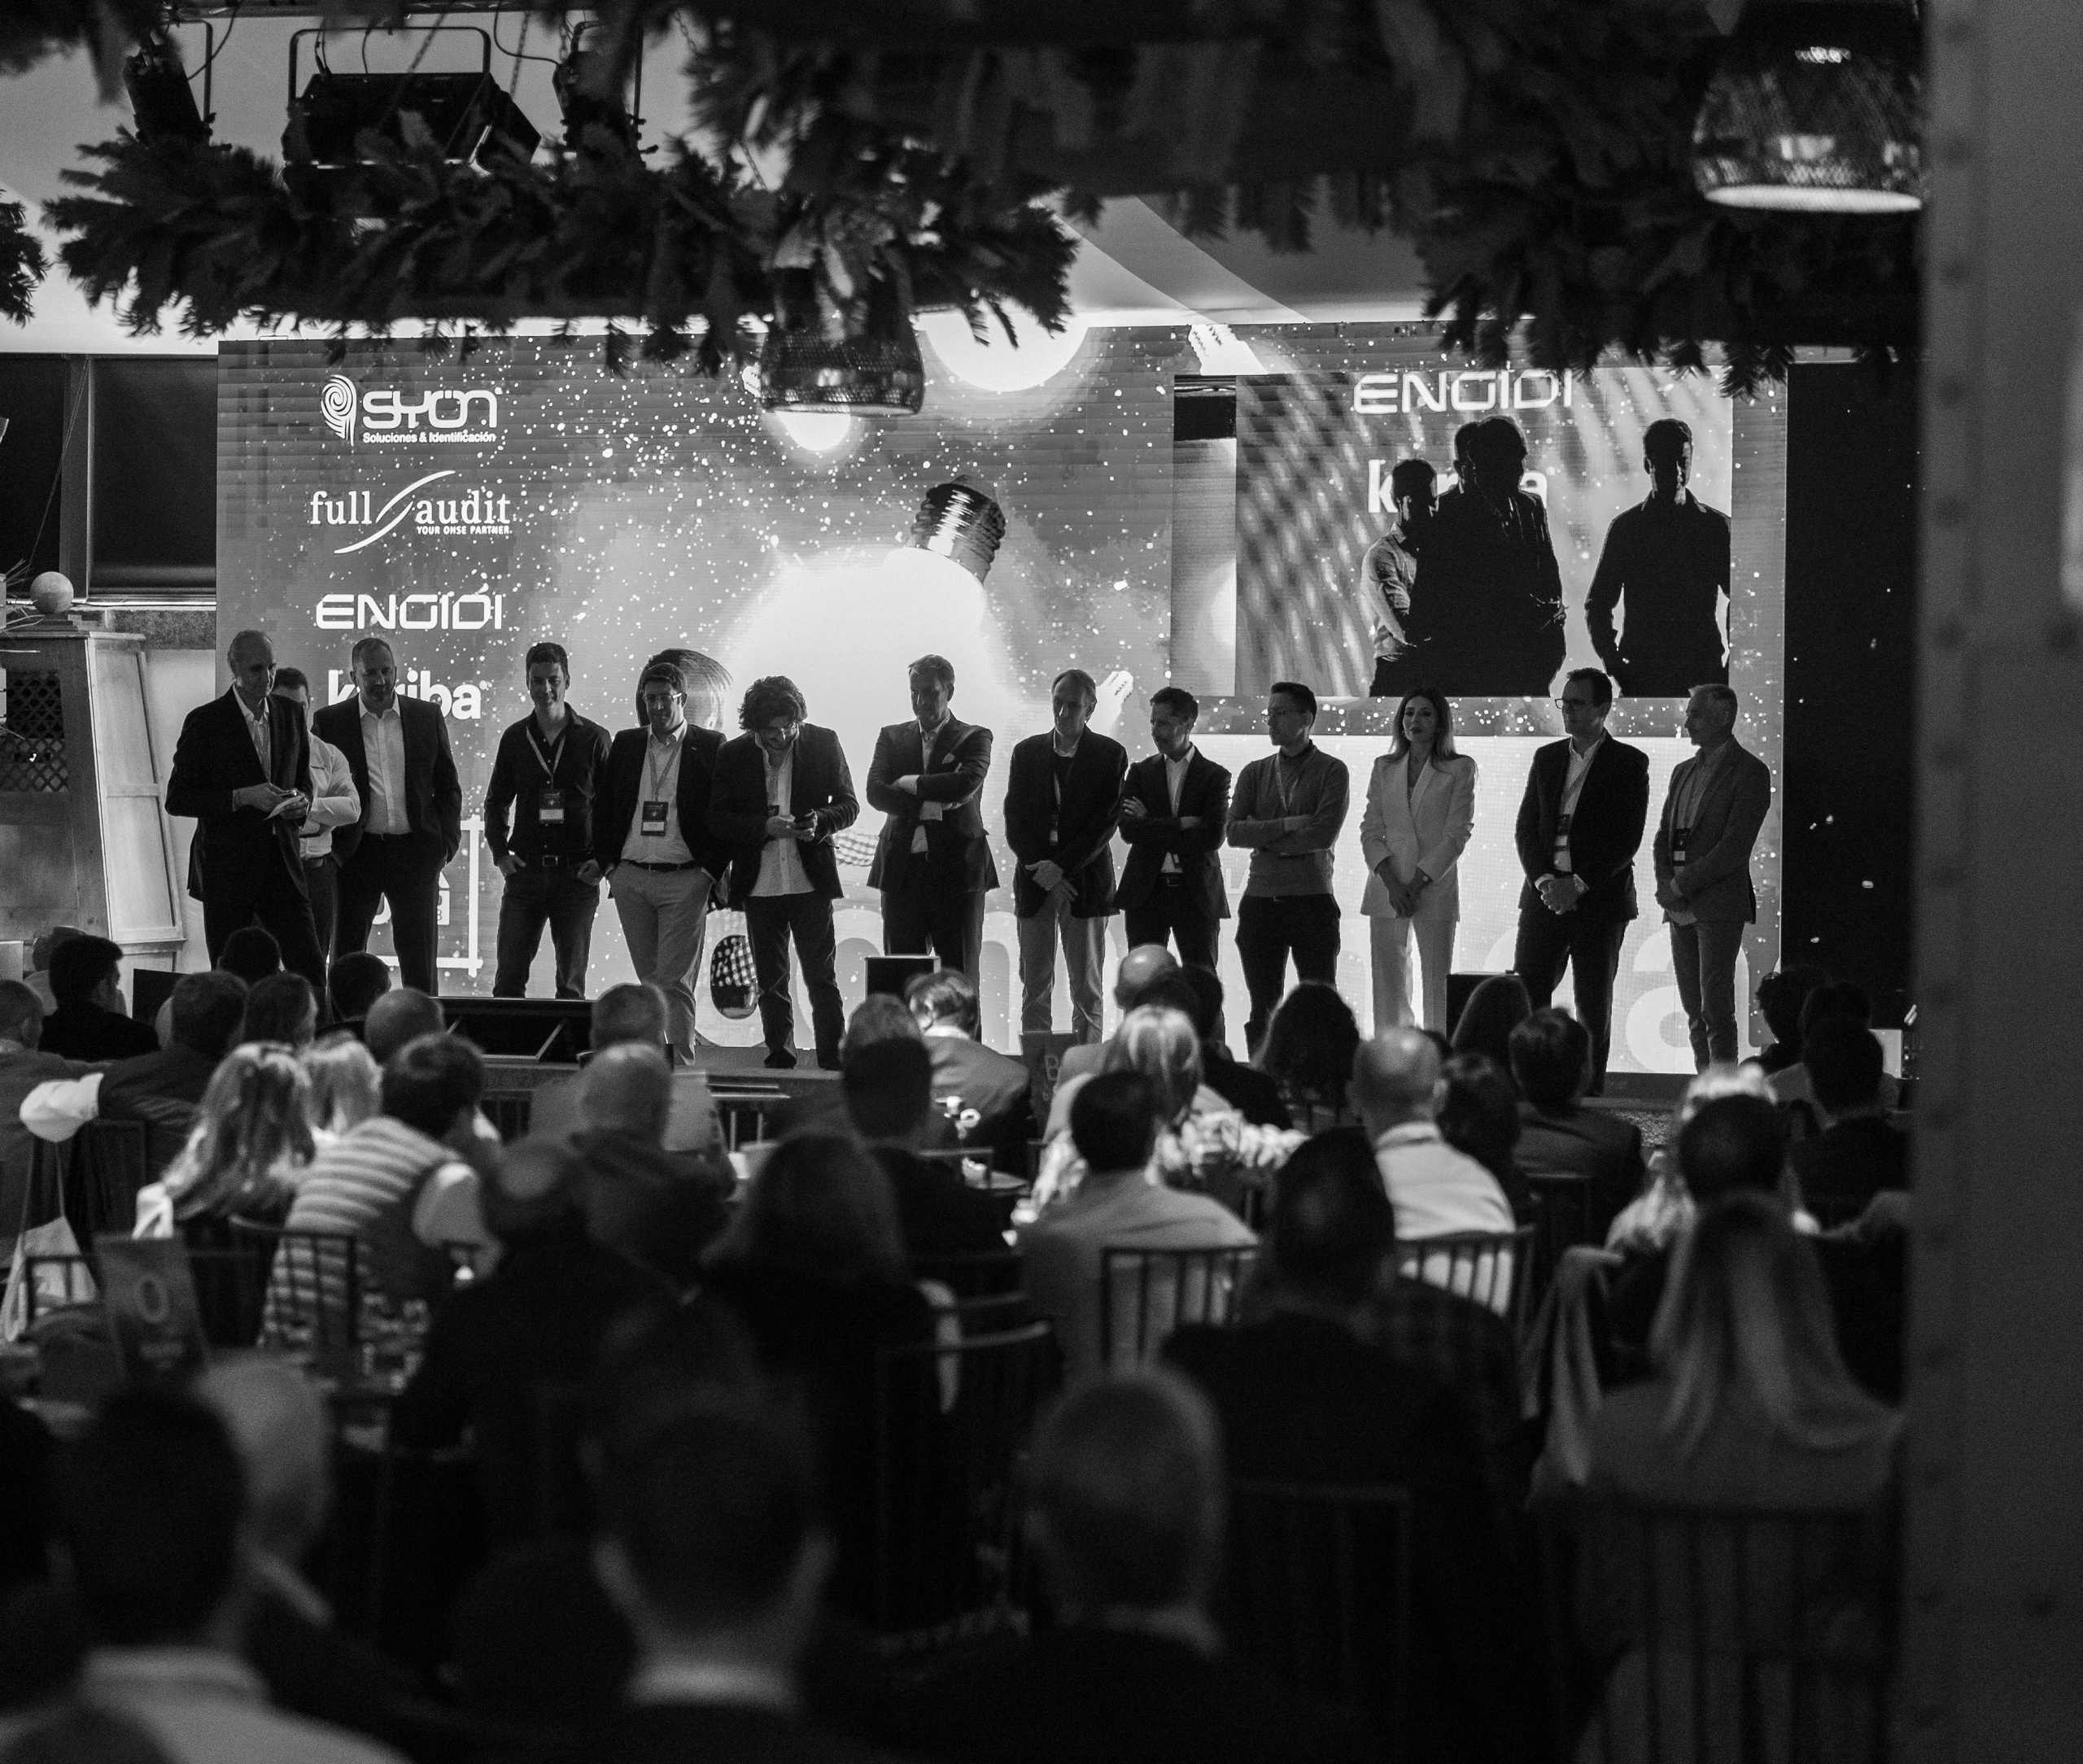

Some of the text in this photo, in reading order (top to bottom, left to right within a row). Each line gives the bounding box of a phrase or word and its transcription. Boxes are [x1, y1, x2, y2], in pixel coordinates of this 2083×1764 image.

[362, 431, 497, 443] Soluciones & Identificación
[310, 490, 511, 525] full audit
[416, 525, 510, 535] YOUR OHSE PARTNER
